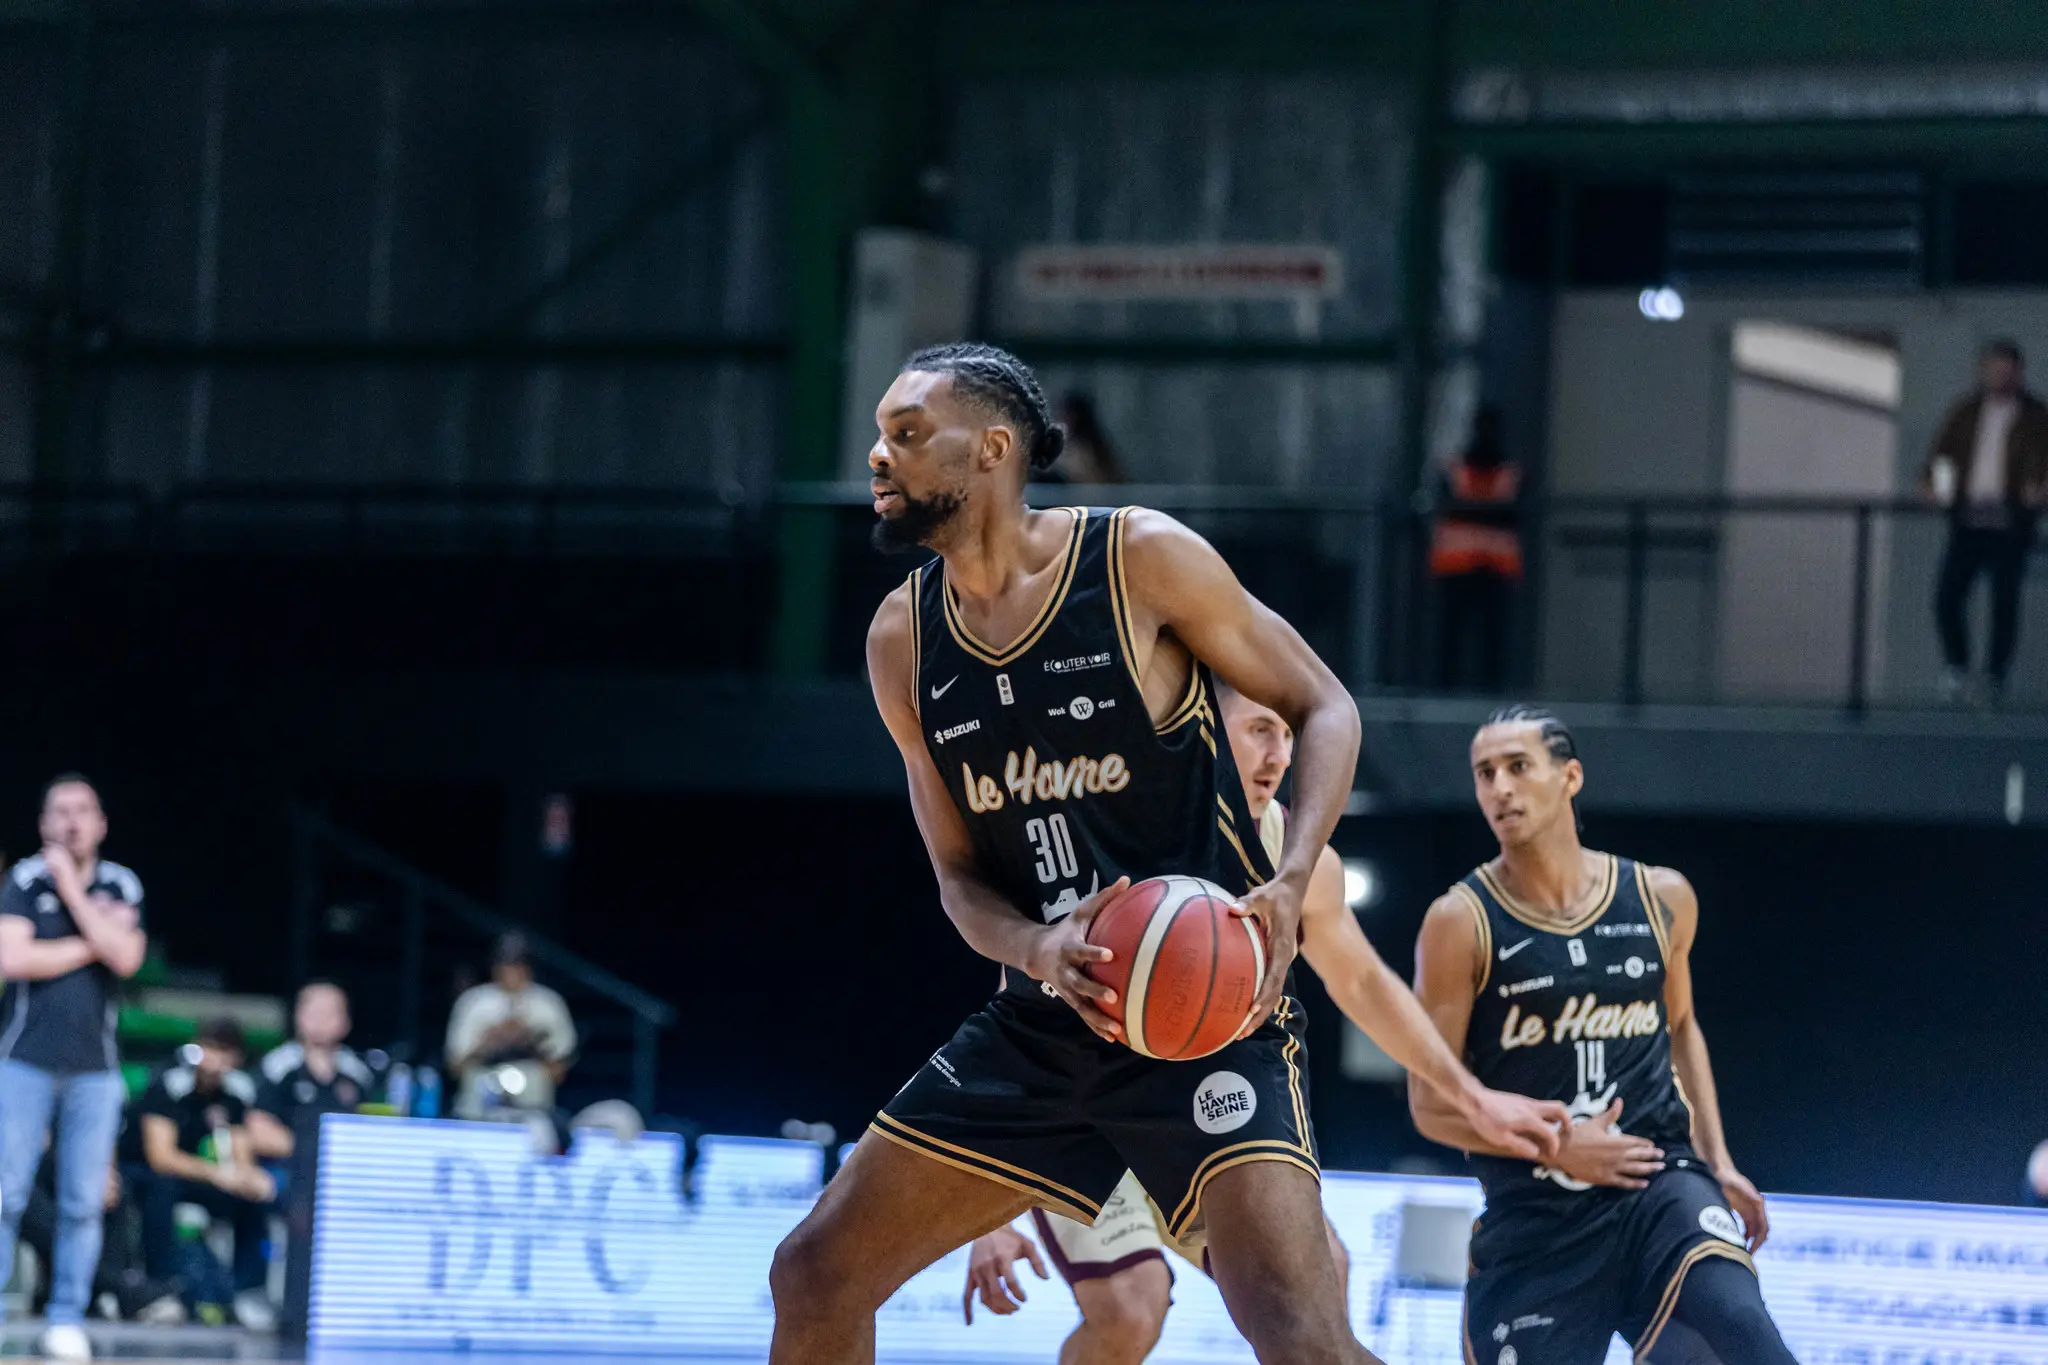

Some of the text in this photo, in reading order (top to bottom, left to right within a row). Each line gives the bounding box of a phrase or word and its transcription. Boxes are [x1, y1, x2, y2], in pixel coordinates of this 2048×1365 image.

[1087, 652, 1111, 664] VOIR
[1048, 706, 1066, 717] Wok
[1098, 699, 1116, 709] Grill
[943, 719, 981, 740] SUZUKI
[1004, 745, 1130, 805] Havre
[1026, 813, 1079, 884] 30
[1500, 1004, 1546, 1050] Le
[1574, 1040, 1605, 1093] 14
[1198, 1089, 1214, 1105] LE
[1201, 1090, 1247, 1114] HAVRE
[1207, 1100, 1249, 1121] SEINE
